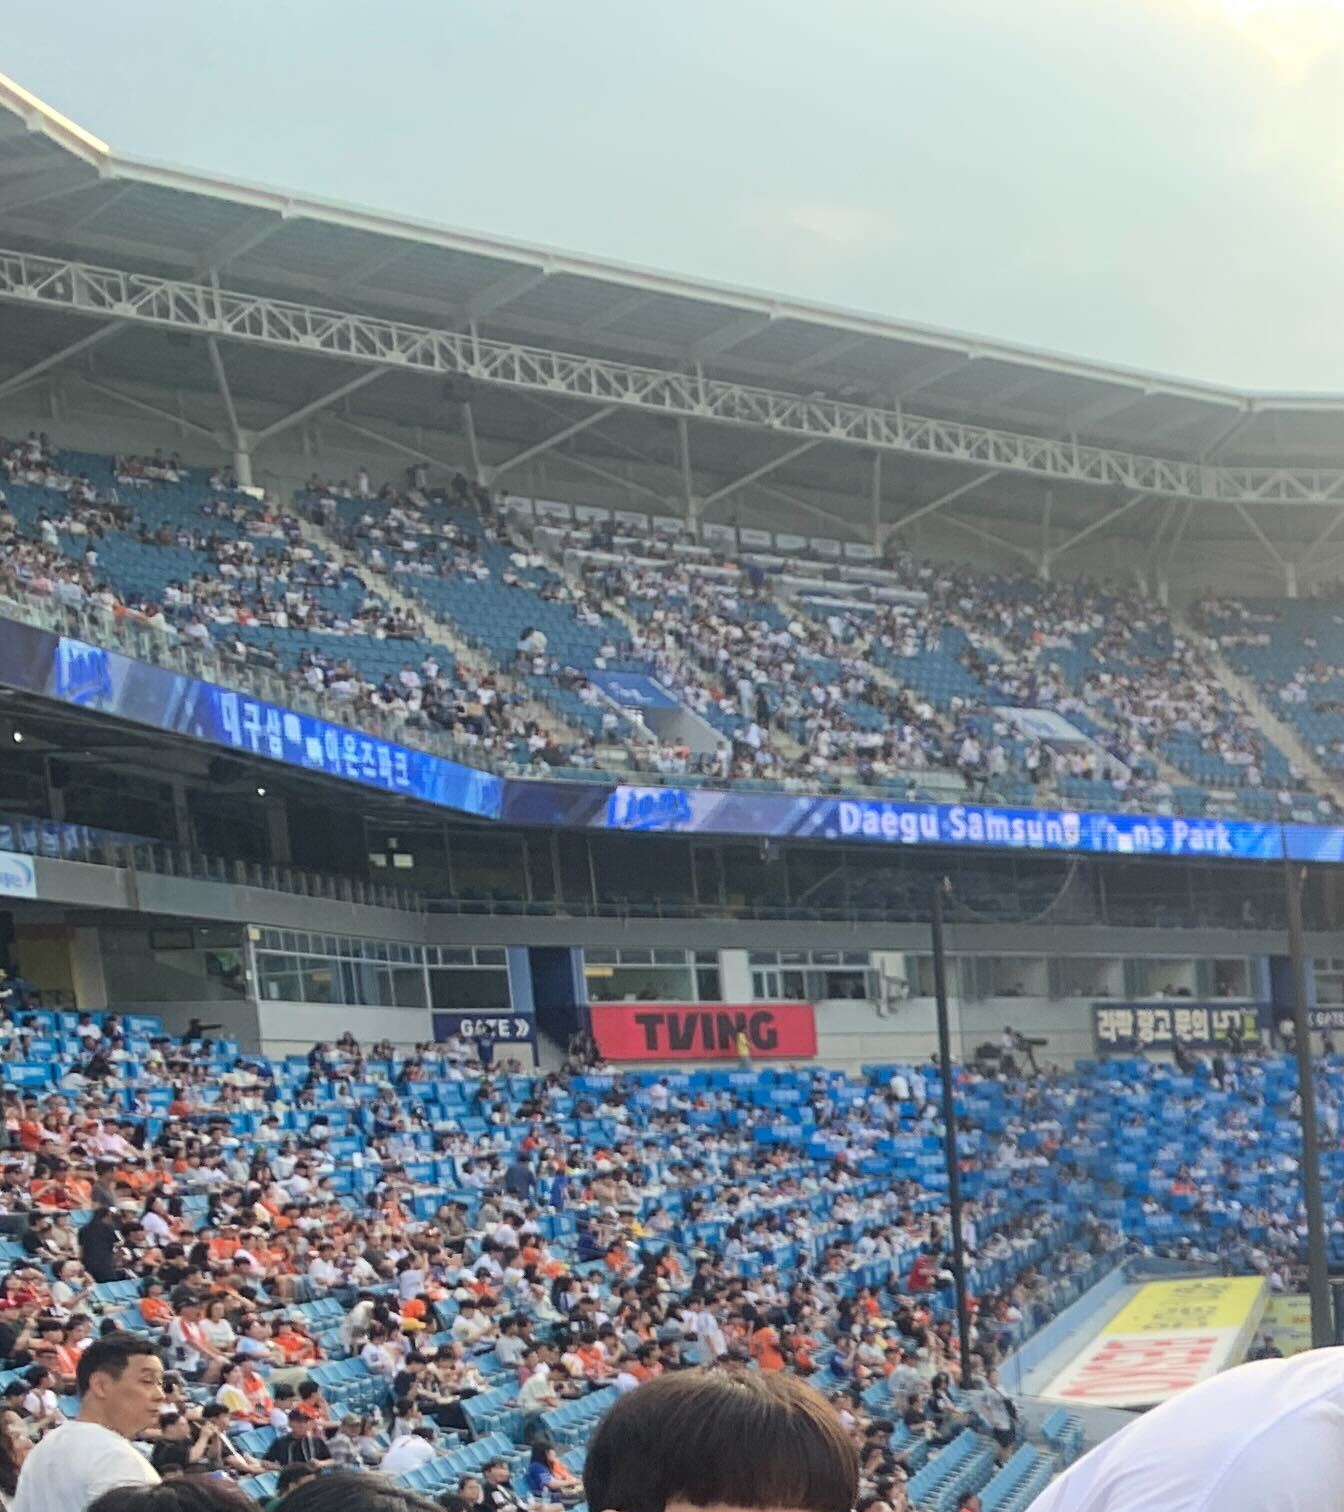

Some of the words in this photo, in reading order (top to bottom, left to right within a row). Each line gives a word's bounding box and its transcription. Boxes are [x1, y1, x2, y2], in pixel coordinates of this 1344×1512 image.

[839, 801, 940, 844] Daegu
[1172, 819, 1232, 854] Park
[460, 1018, 510, 1037] GATE
[635, 1012, 777, 1050] TVING
